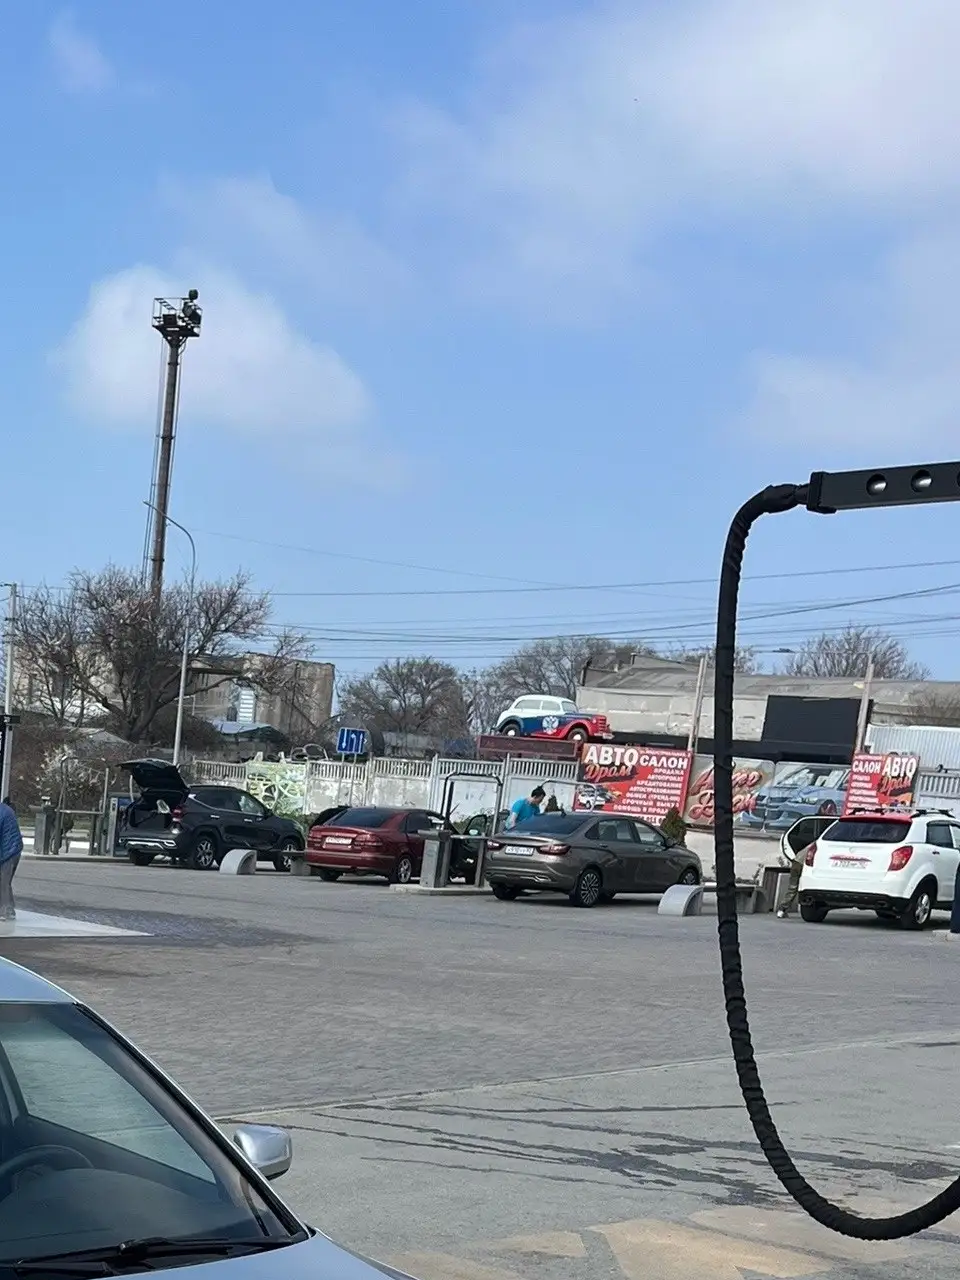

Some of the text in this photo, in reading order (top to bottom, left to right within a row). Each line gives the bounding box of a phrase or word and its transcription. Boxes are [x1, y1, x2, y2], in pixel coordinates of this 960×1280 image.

[584, 745, 689, 769] АВТО САЛОН
[852, 756, 917, 778] САЛОН АВТО
